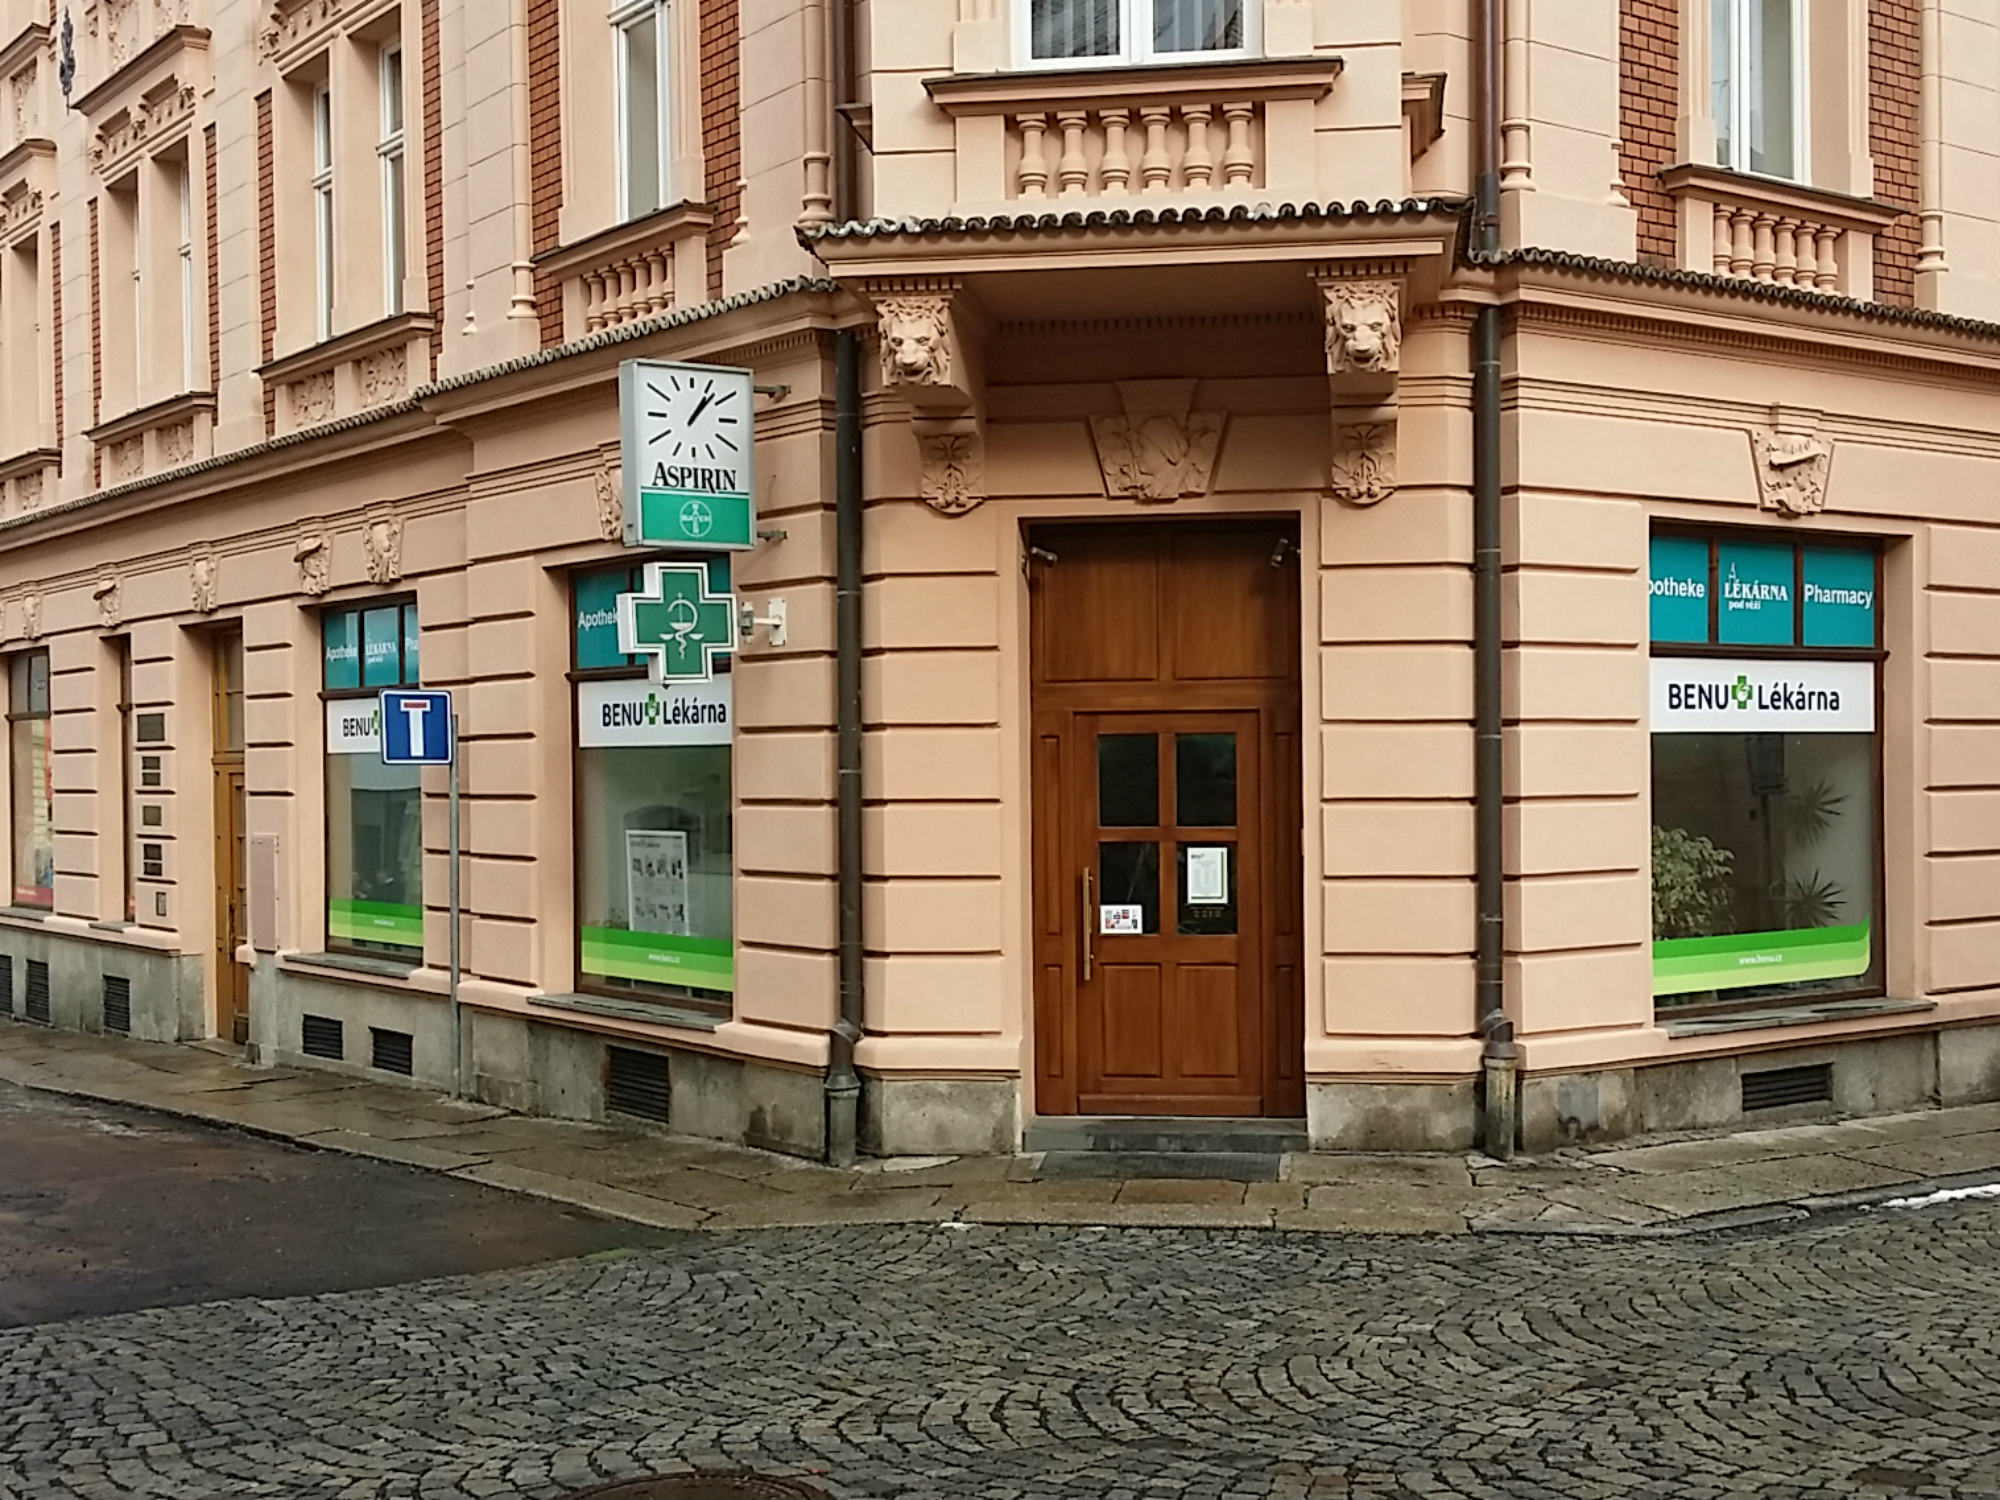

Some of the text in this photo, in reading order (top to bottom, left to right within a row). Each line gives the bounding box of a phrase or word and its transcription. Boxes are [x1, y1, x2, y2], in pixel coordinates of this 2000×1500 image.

[652, 461, 737, 494] ASPIRIN
[1648, 576, 1705, 598] potheke
[1724, 578, 1789, 601] LÉKÁRNA
[1804, 584, 1873, 609] Pharmacy
[577, 607, 618, 632] Apothek
[1668, 682, 1840, 711] BENU Lékárna
[602, 697, 727, 727] BENU Lékárna
[343, 717, 371, 738] BENU
